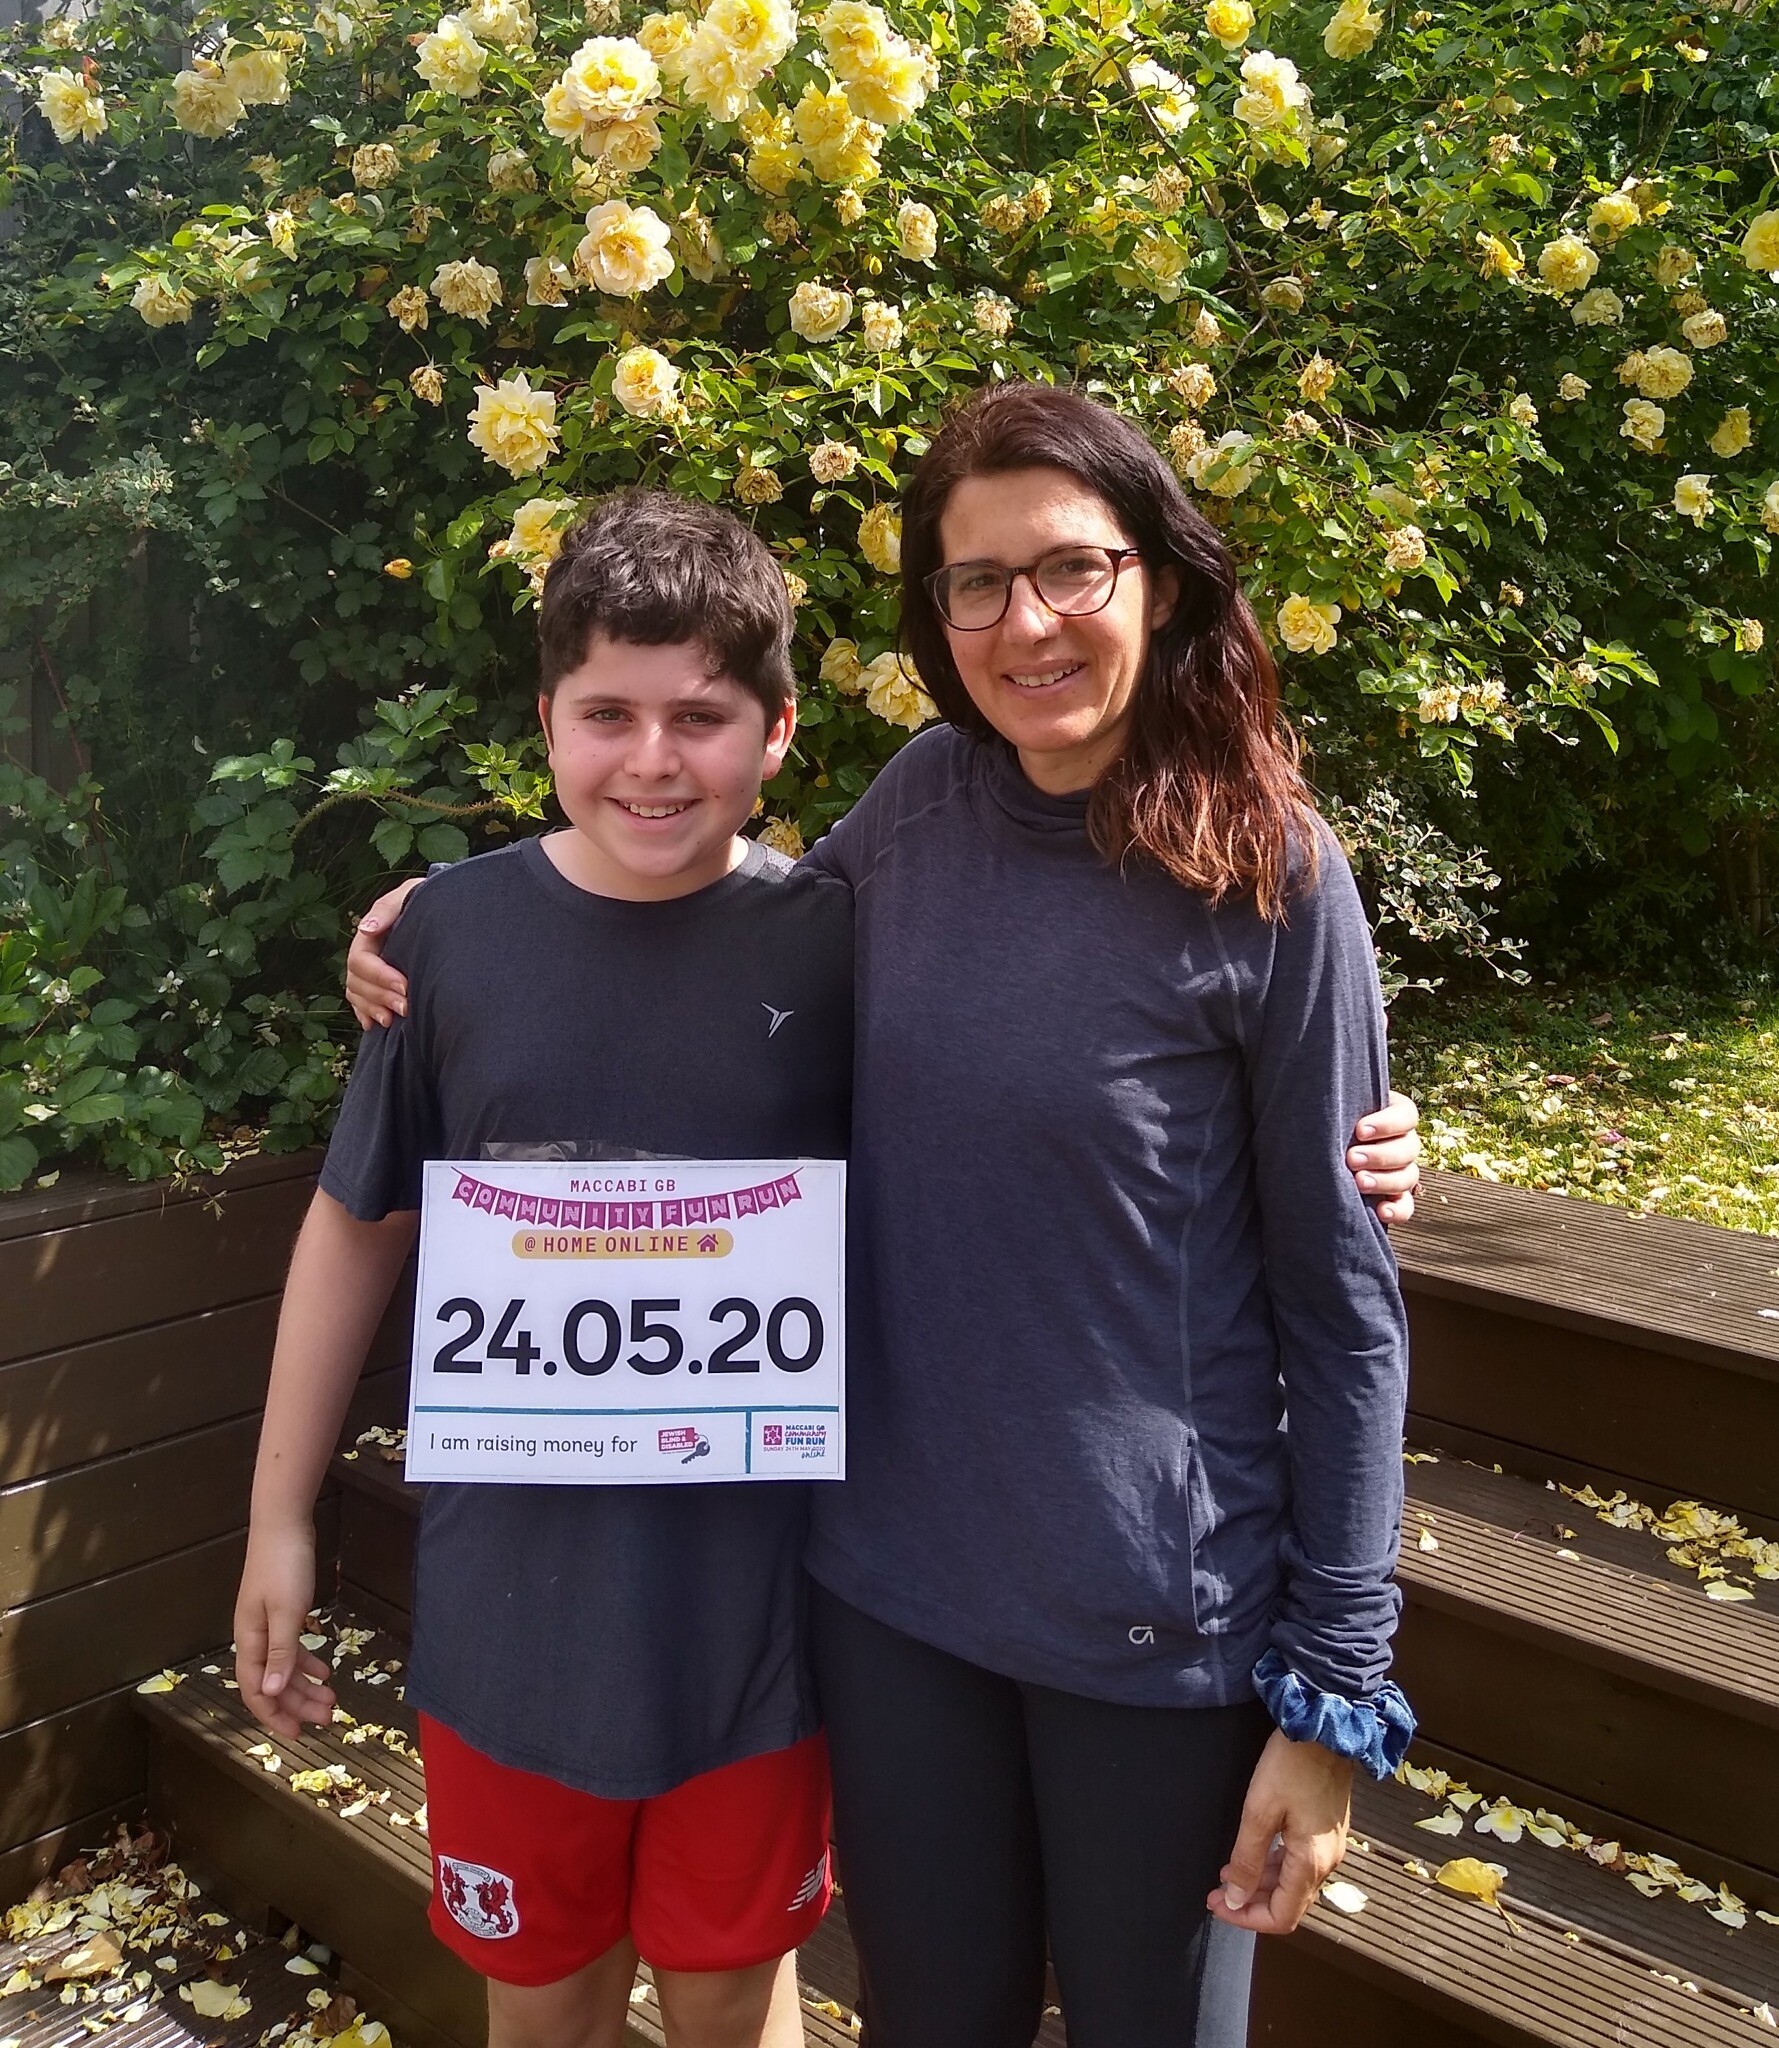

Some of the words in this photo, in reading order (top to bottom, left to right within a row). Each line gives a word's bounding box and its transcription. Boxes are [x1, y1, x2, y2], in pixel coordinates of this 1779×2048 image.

[570, 1179, 647, 1192] MACCABI
[655, 1179, 676, 1192] GB
[458, 1180, 650, 1223] COMMUNITY
[665, 1198, 727, 1220] FUN
[737, 1180, 796, 1211] RUN
[524, 1236, 536, 1252] @
[543, 1236, 597, 1253] HOME
[605, 1236, 689, 1252] ONLINE
[432, 1296, 825, 1376] 24.05.20
[661, 1430, 686, 1438] JEWISH
[785, 1437, 804, 1446] FUN
[805, 1437, 825, 1446] RUN
[430, 1433, 435, 1450] I
[441, 1437, 470, 1450] am
[476, 1434, 537, 1457] raising
[543, 1439, 604, 1458] money
[610, 1435, 638, 1453] for
[661, 1441, 694, 1450] DISABLED
